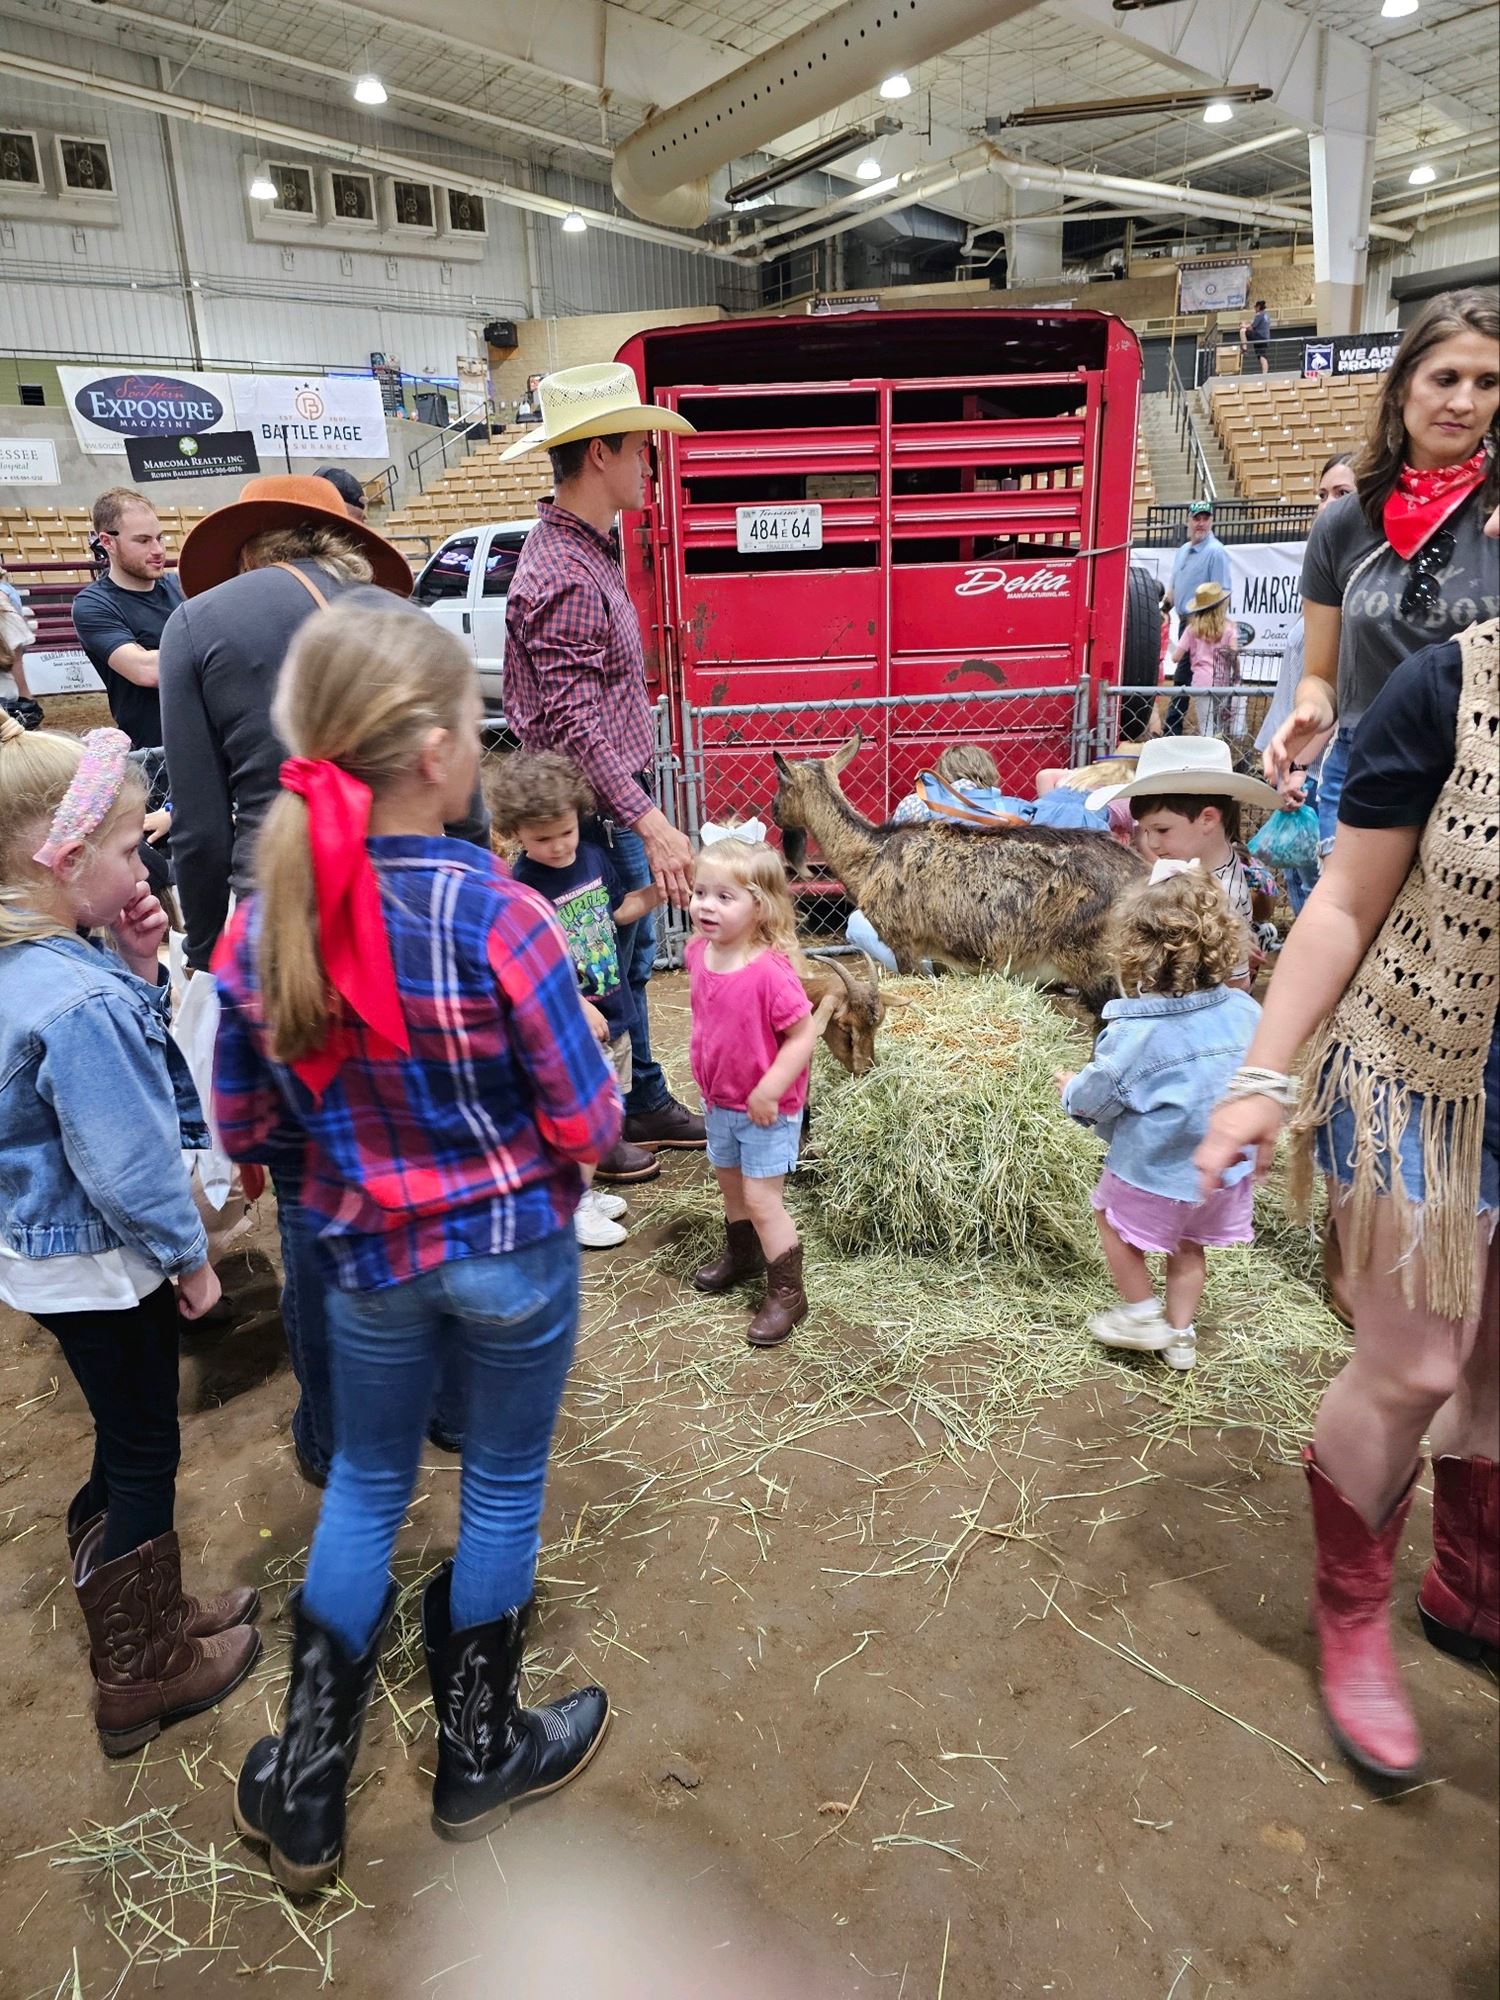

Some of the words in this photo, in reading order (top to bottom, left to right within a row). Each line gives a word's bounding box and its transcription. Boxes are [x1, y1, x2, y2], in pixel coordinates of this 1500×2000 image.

[1339, 348, 1367, 361] WE
[1338, 357, 1396, 372] PRORO
[115, 376, 185, 399] Southern
[87, 390, 215, 421] EXPOSURE
[119, 419, 191, 429] MAGAZINE
[261, 423, 319, 440] BATTLE
[323, 425, 363, 441] PAGE
[278, 442, 348, 451] ISURANCE
[143, 458, 190, 470] MARCOMA
[226, 455, 245, 464] INC.
[750, 519, 778, 540] 484
[791, 517, 810, 538] 64
[954, 567, 1072, 597] Delta
[1242, 575, 1303, 615] MARSH
